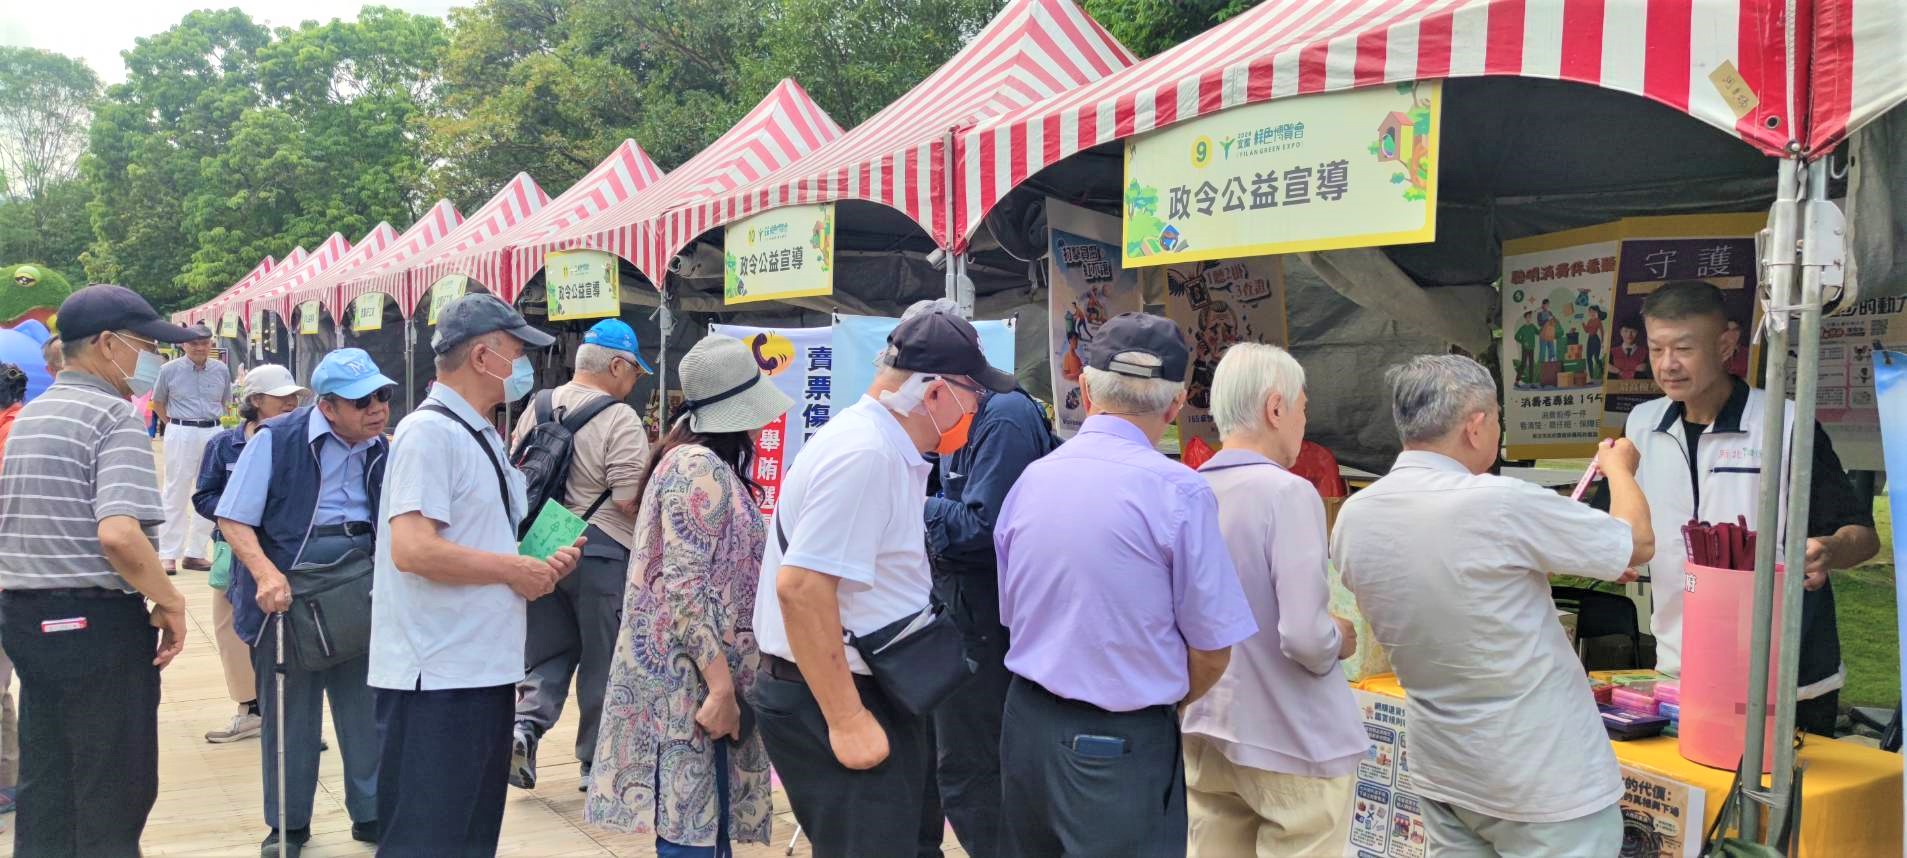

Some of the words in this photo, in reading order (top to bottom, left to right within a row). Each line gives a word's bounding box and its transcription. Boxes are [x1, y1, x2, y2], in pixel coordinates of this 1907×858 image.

[1196, 141, 1207, 162] 9
[1260, 144, 1280, 154] GREEN
[1282, 141, 1301, 151] EXPO
[1169, 159, 1349, 220] 政令公益宣導
[740, 246, 803, 276] 政令公益宣導
[1645, 245, 1733, 279] 守護
[558, 281, 600, 300] 政令公益宣導
[755, 415, 783, 530] 舉賄選
[1622, 775, 1672, 801] 的代價：
